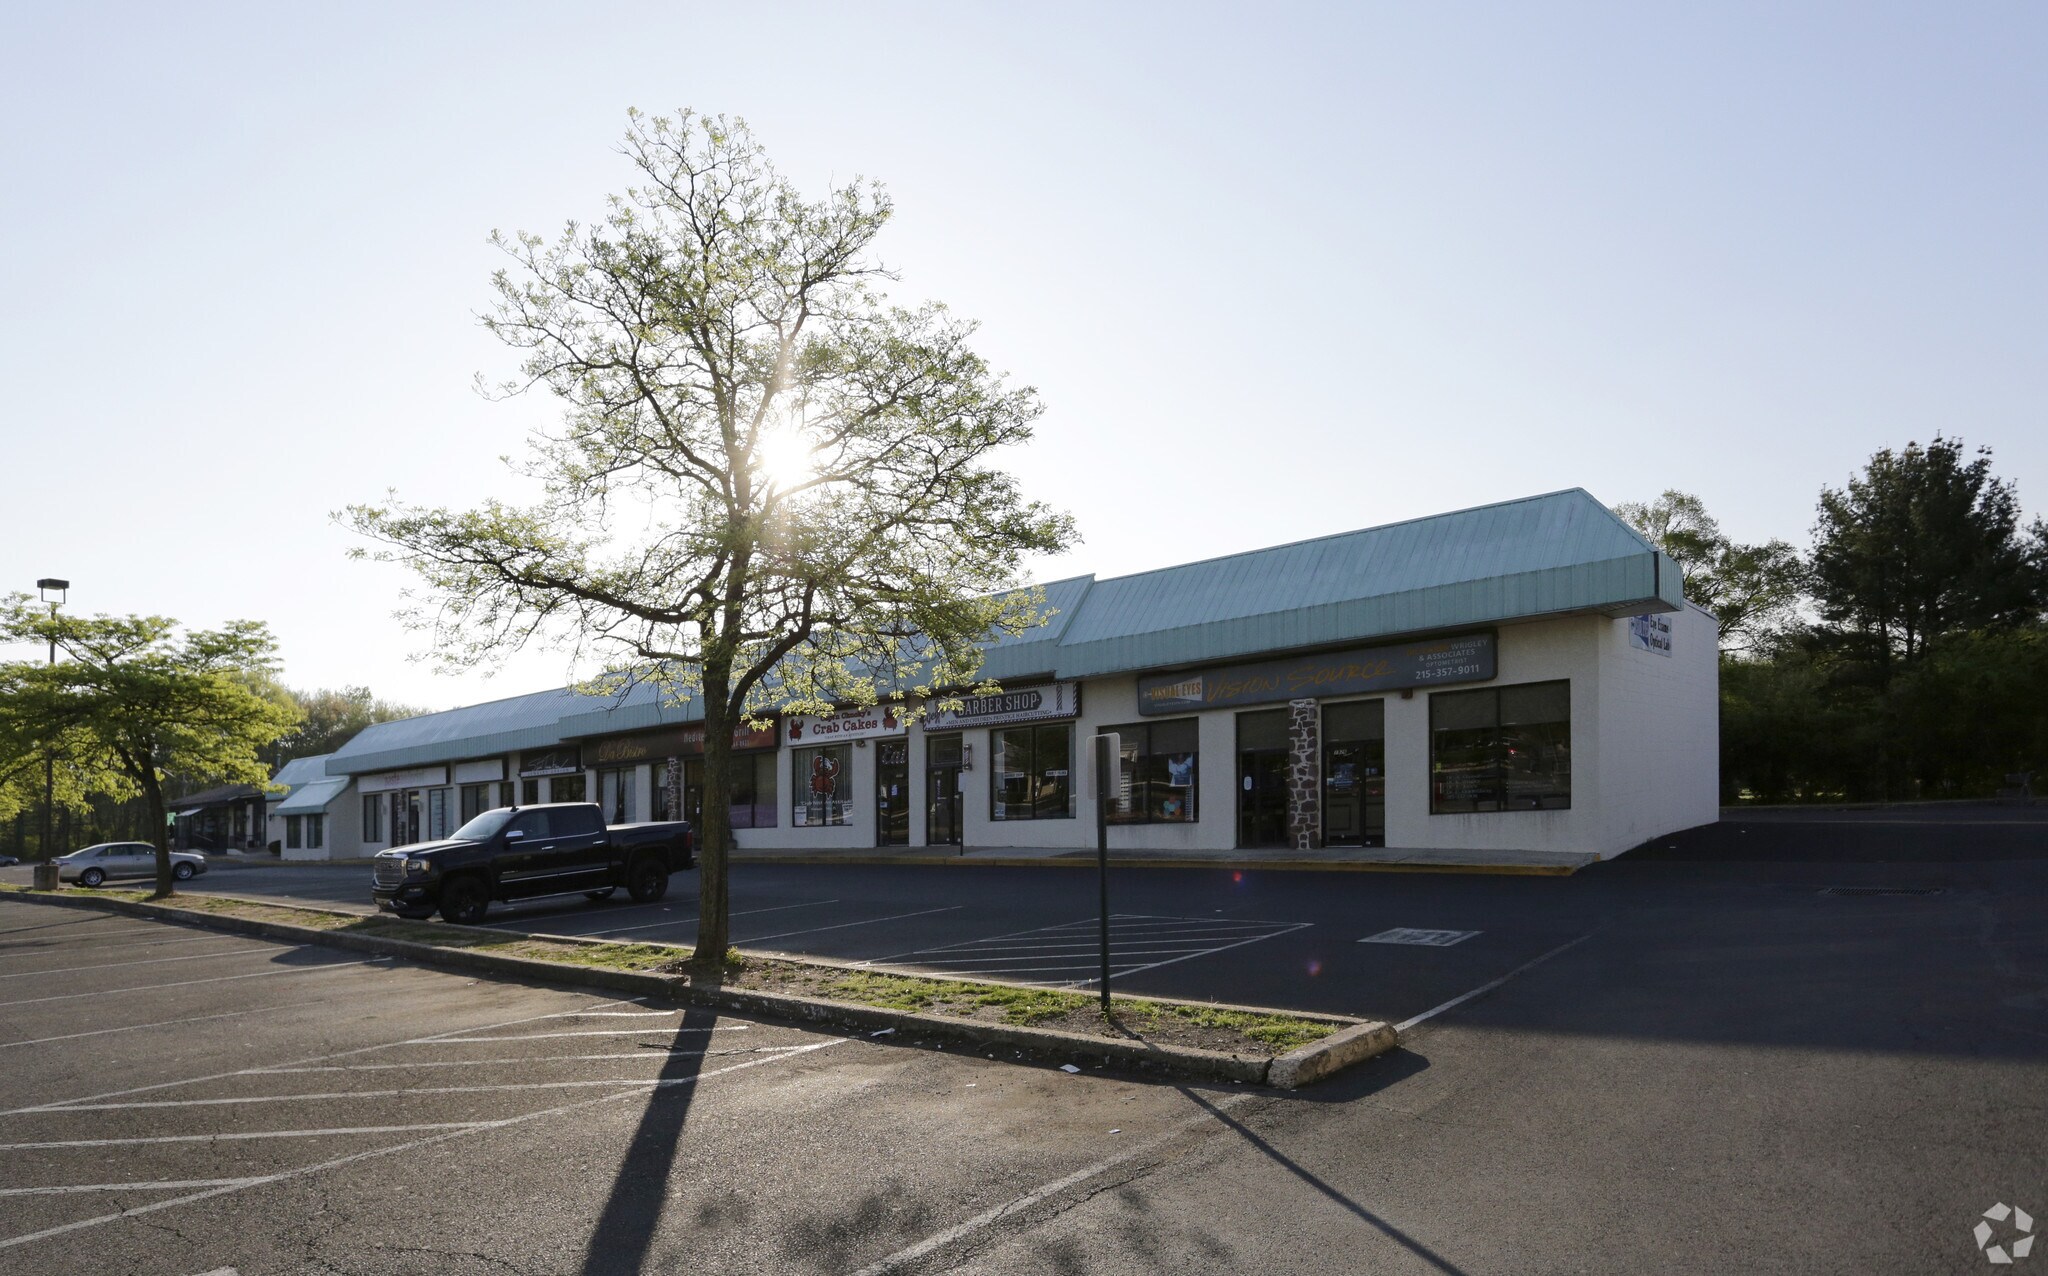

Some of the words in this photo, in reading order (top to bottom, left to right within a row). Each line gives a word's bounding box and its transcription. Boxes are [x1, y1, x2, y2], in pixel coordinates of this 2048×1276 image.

[1451, 639, 1488, 650] WRIGLEY
[1418, 654, 1425, 663] &
[1427, 648, 1476, 661] ASSOCIATES
[1415, 664, 1479, 680] 215-357-9011
[1182, 682, 1201, 696] EYES
[1006, 693, 1037, 711] SHOP
[813, 722, 840, 735] Crab
[843, 719, 878, 732] Cakes
